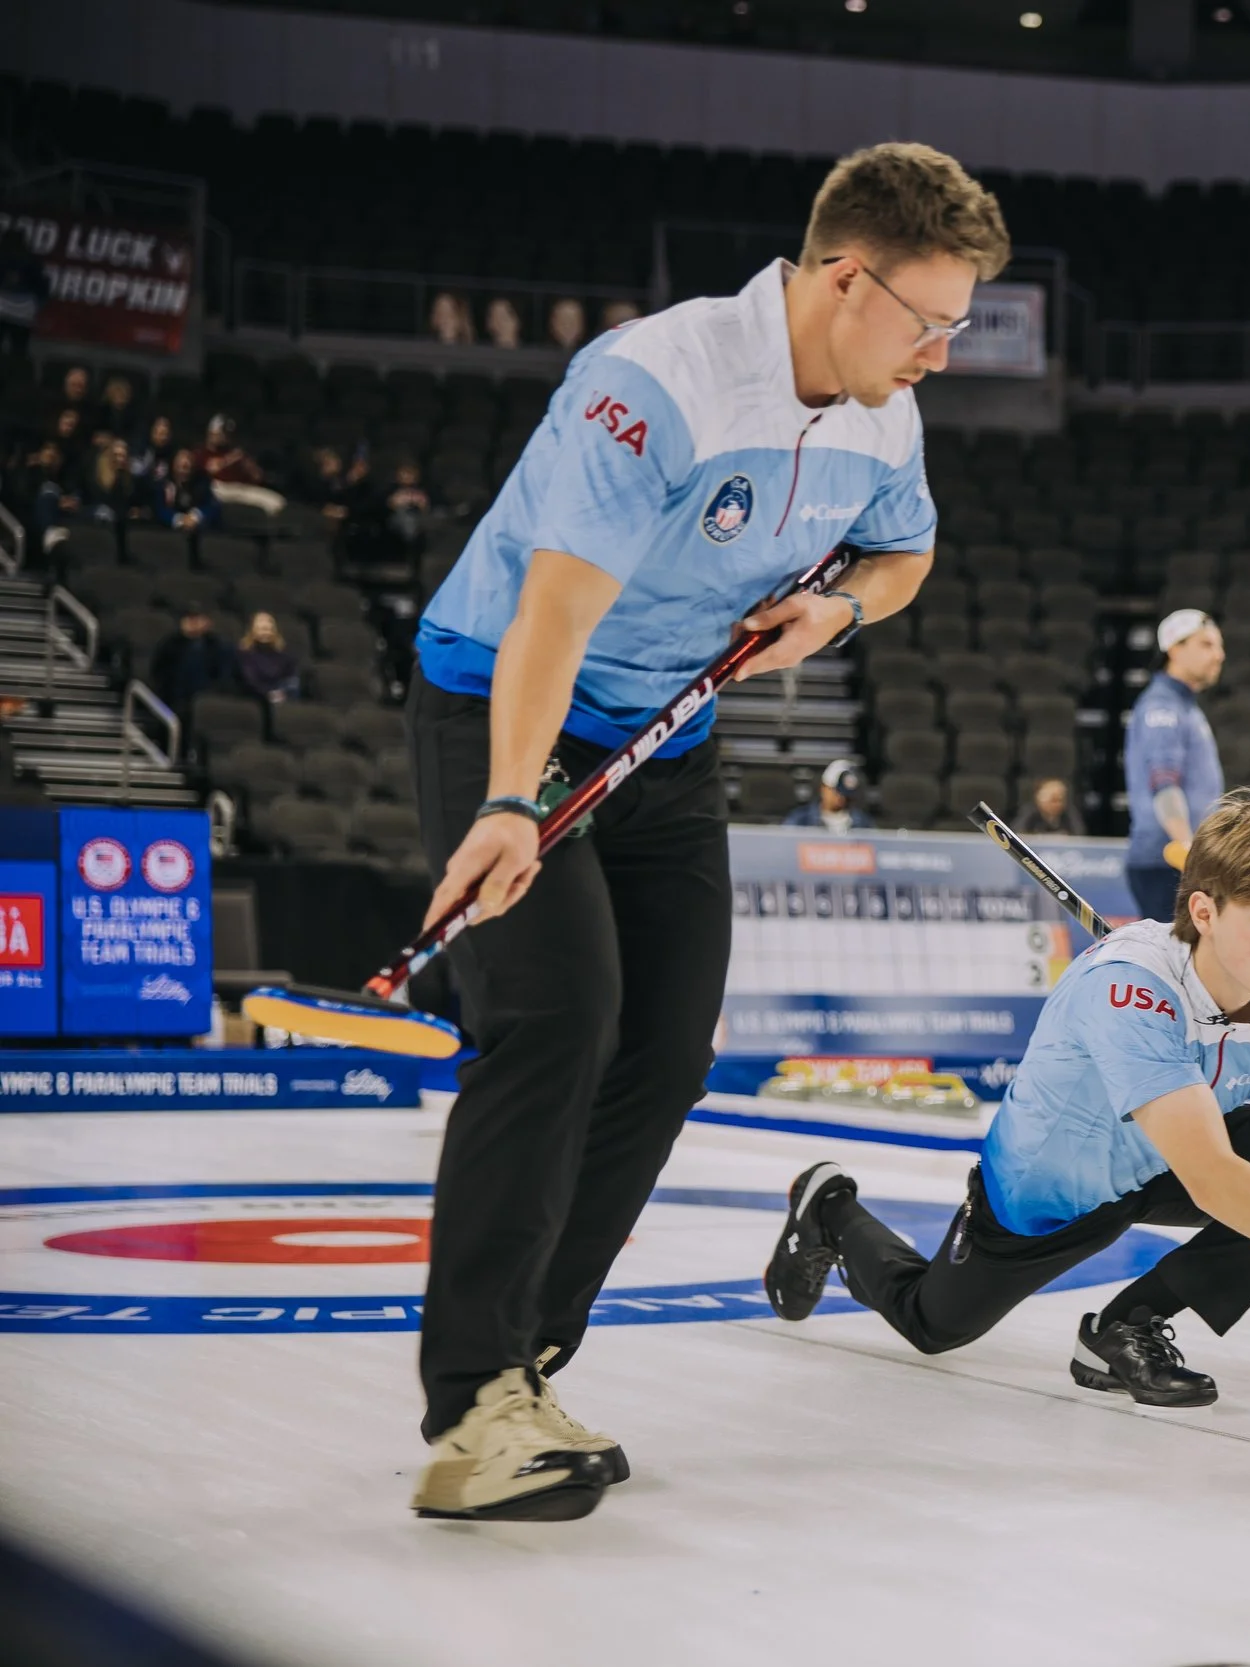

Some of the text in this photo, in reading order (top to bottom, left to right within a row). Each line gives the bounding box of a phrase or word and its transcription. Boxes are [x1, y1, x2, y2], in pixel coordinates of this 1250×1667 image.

[66, 224, 157, 270] LUCK
[584, 390, 648, 458] USA
[109, 896, 184, 920] OLYMPIC
[82, 918, 190, 942] PARALYMPIC
[81, 941, 196, 966] TEAM TRIALS
[1109, 982, 1178, 1023] USA
[0, 1072, 53, 1096] YMPIC
[72, 1071, 176, 1096] PARALYMPIC
[178, 1071, 221, 1096] TEAM
[222, 1072, 278, 1096] TRIALS
